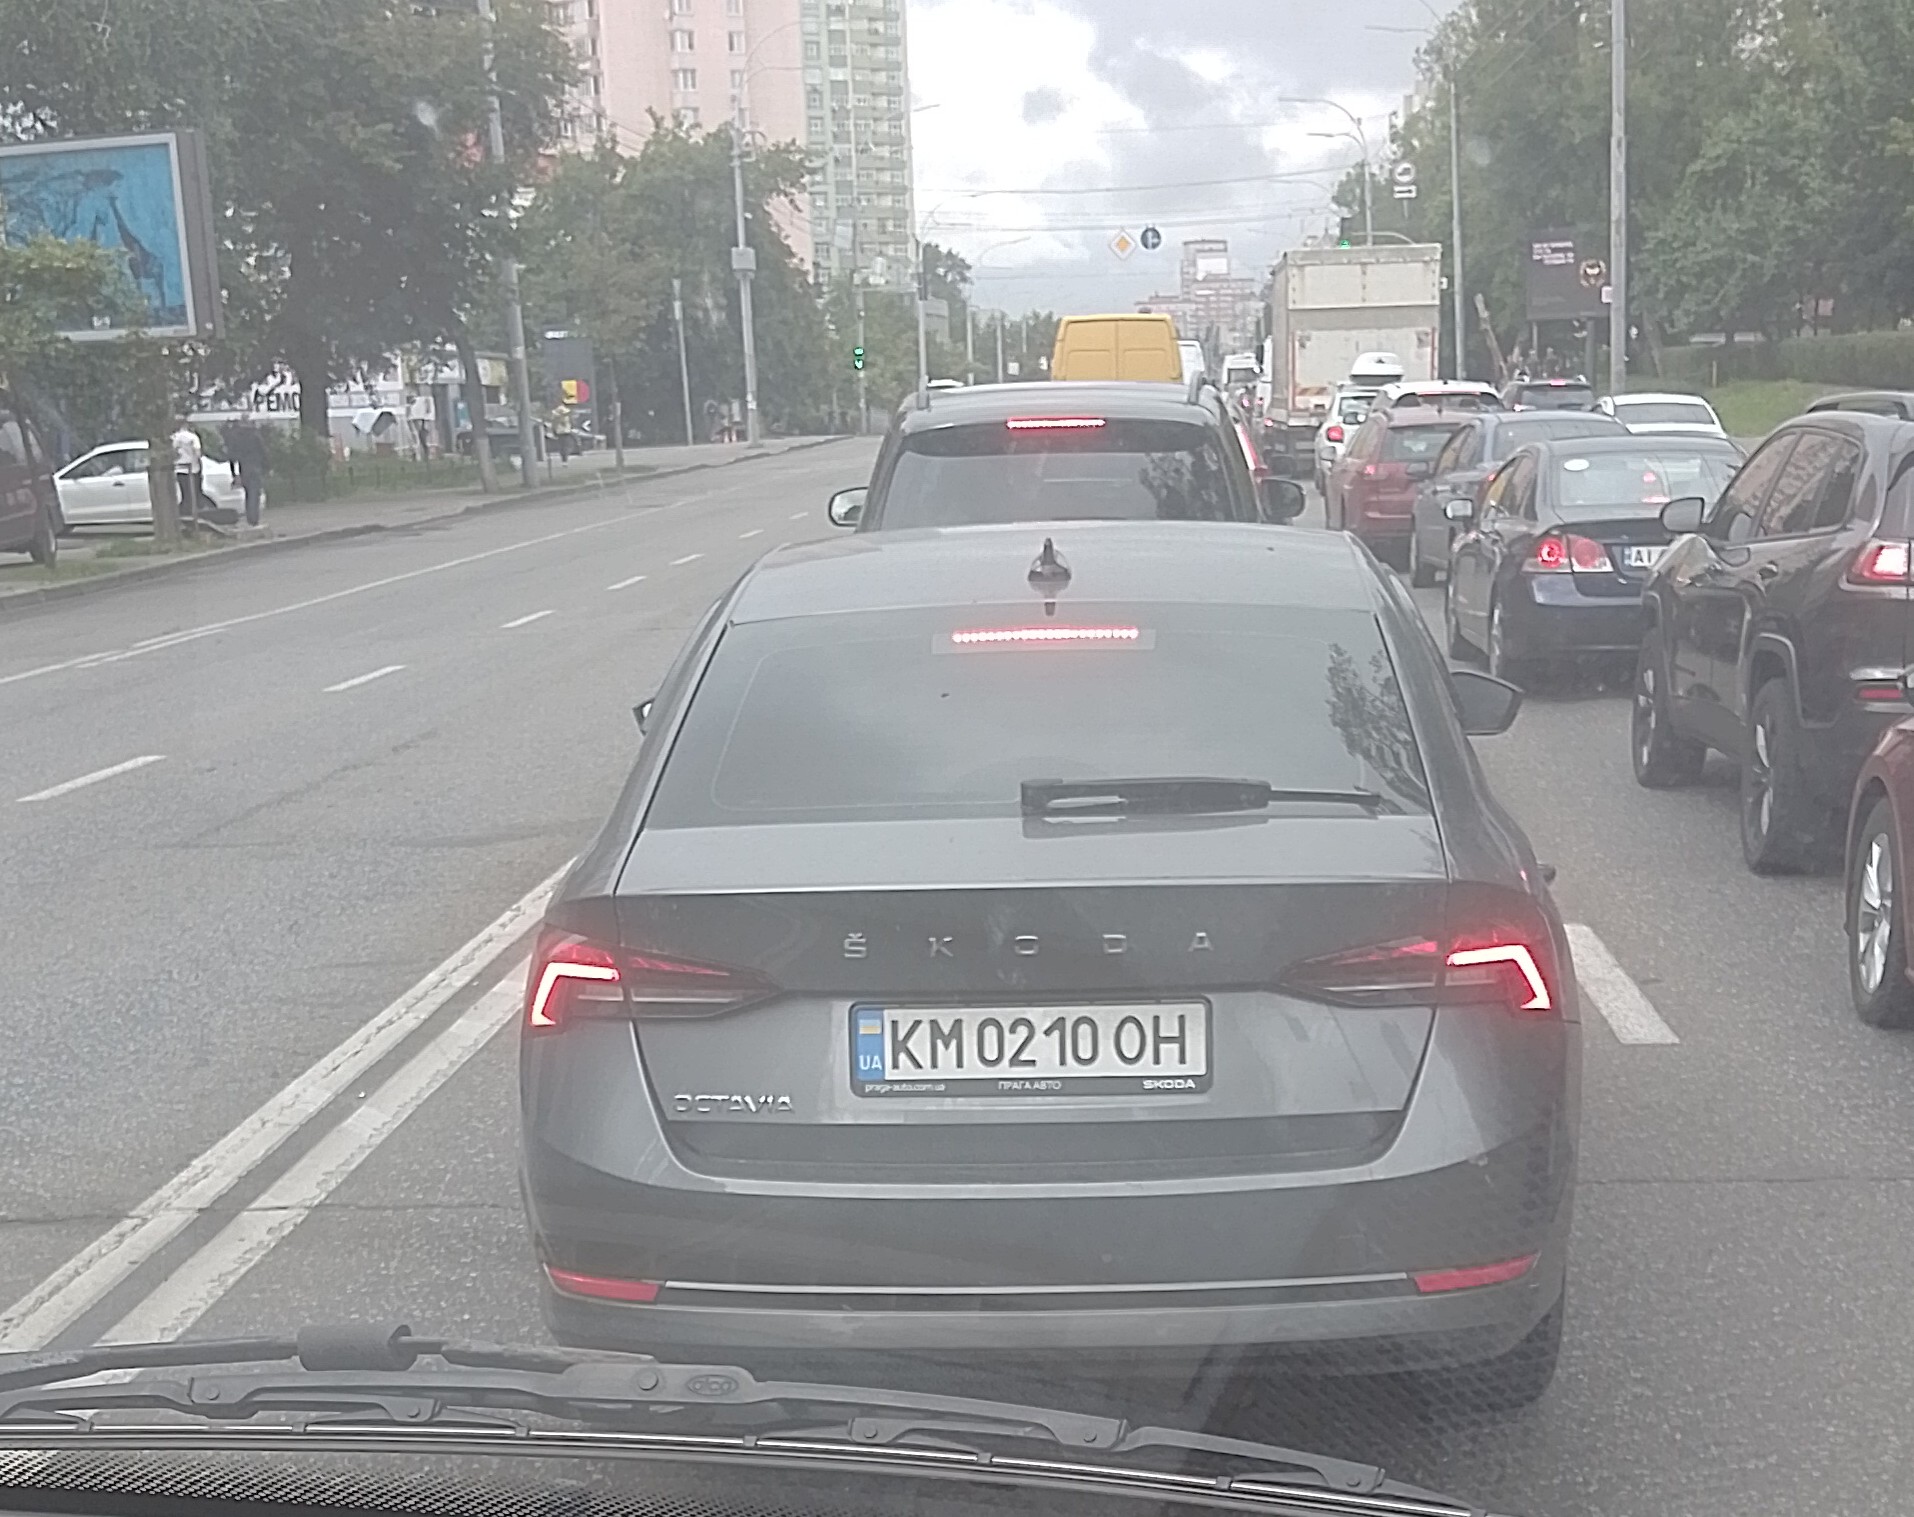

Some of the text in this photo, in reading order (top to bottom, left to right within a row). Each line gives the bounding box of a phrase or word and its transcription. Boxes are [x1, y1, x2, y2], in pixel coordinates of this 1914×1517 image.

[859, 1055, 883, 1070] UA
[1033, 1080, 1062, 1090] АВТО
[674, 1094, 795, 1113] OCTAVIA
